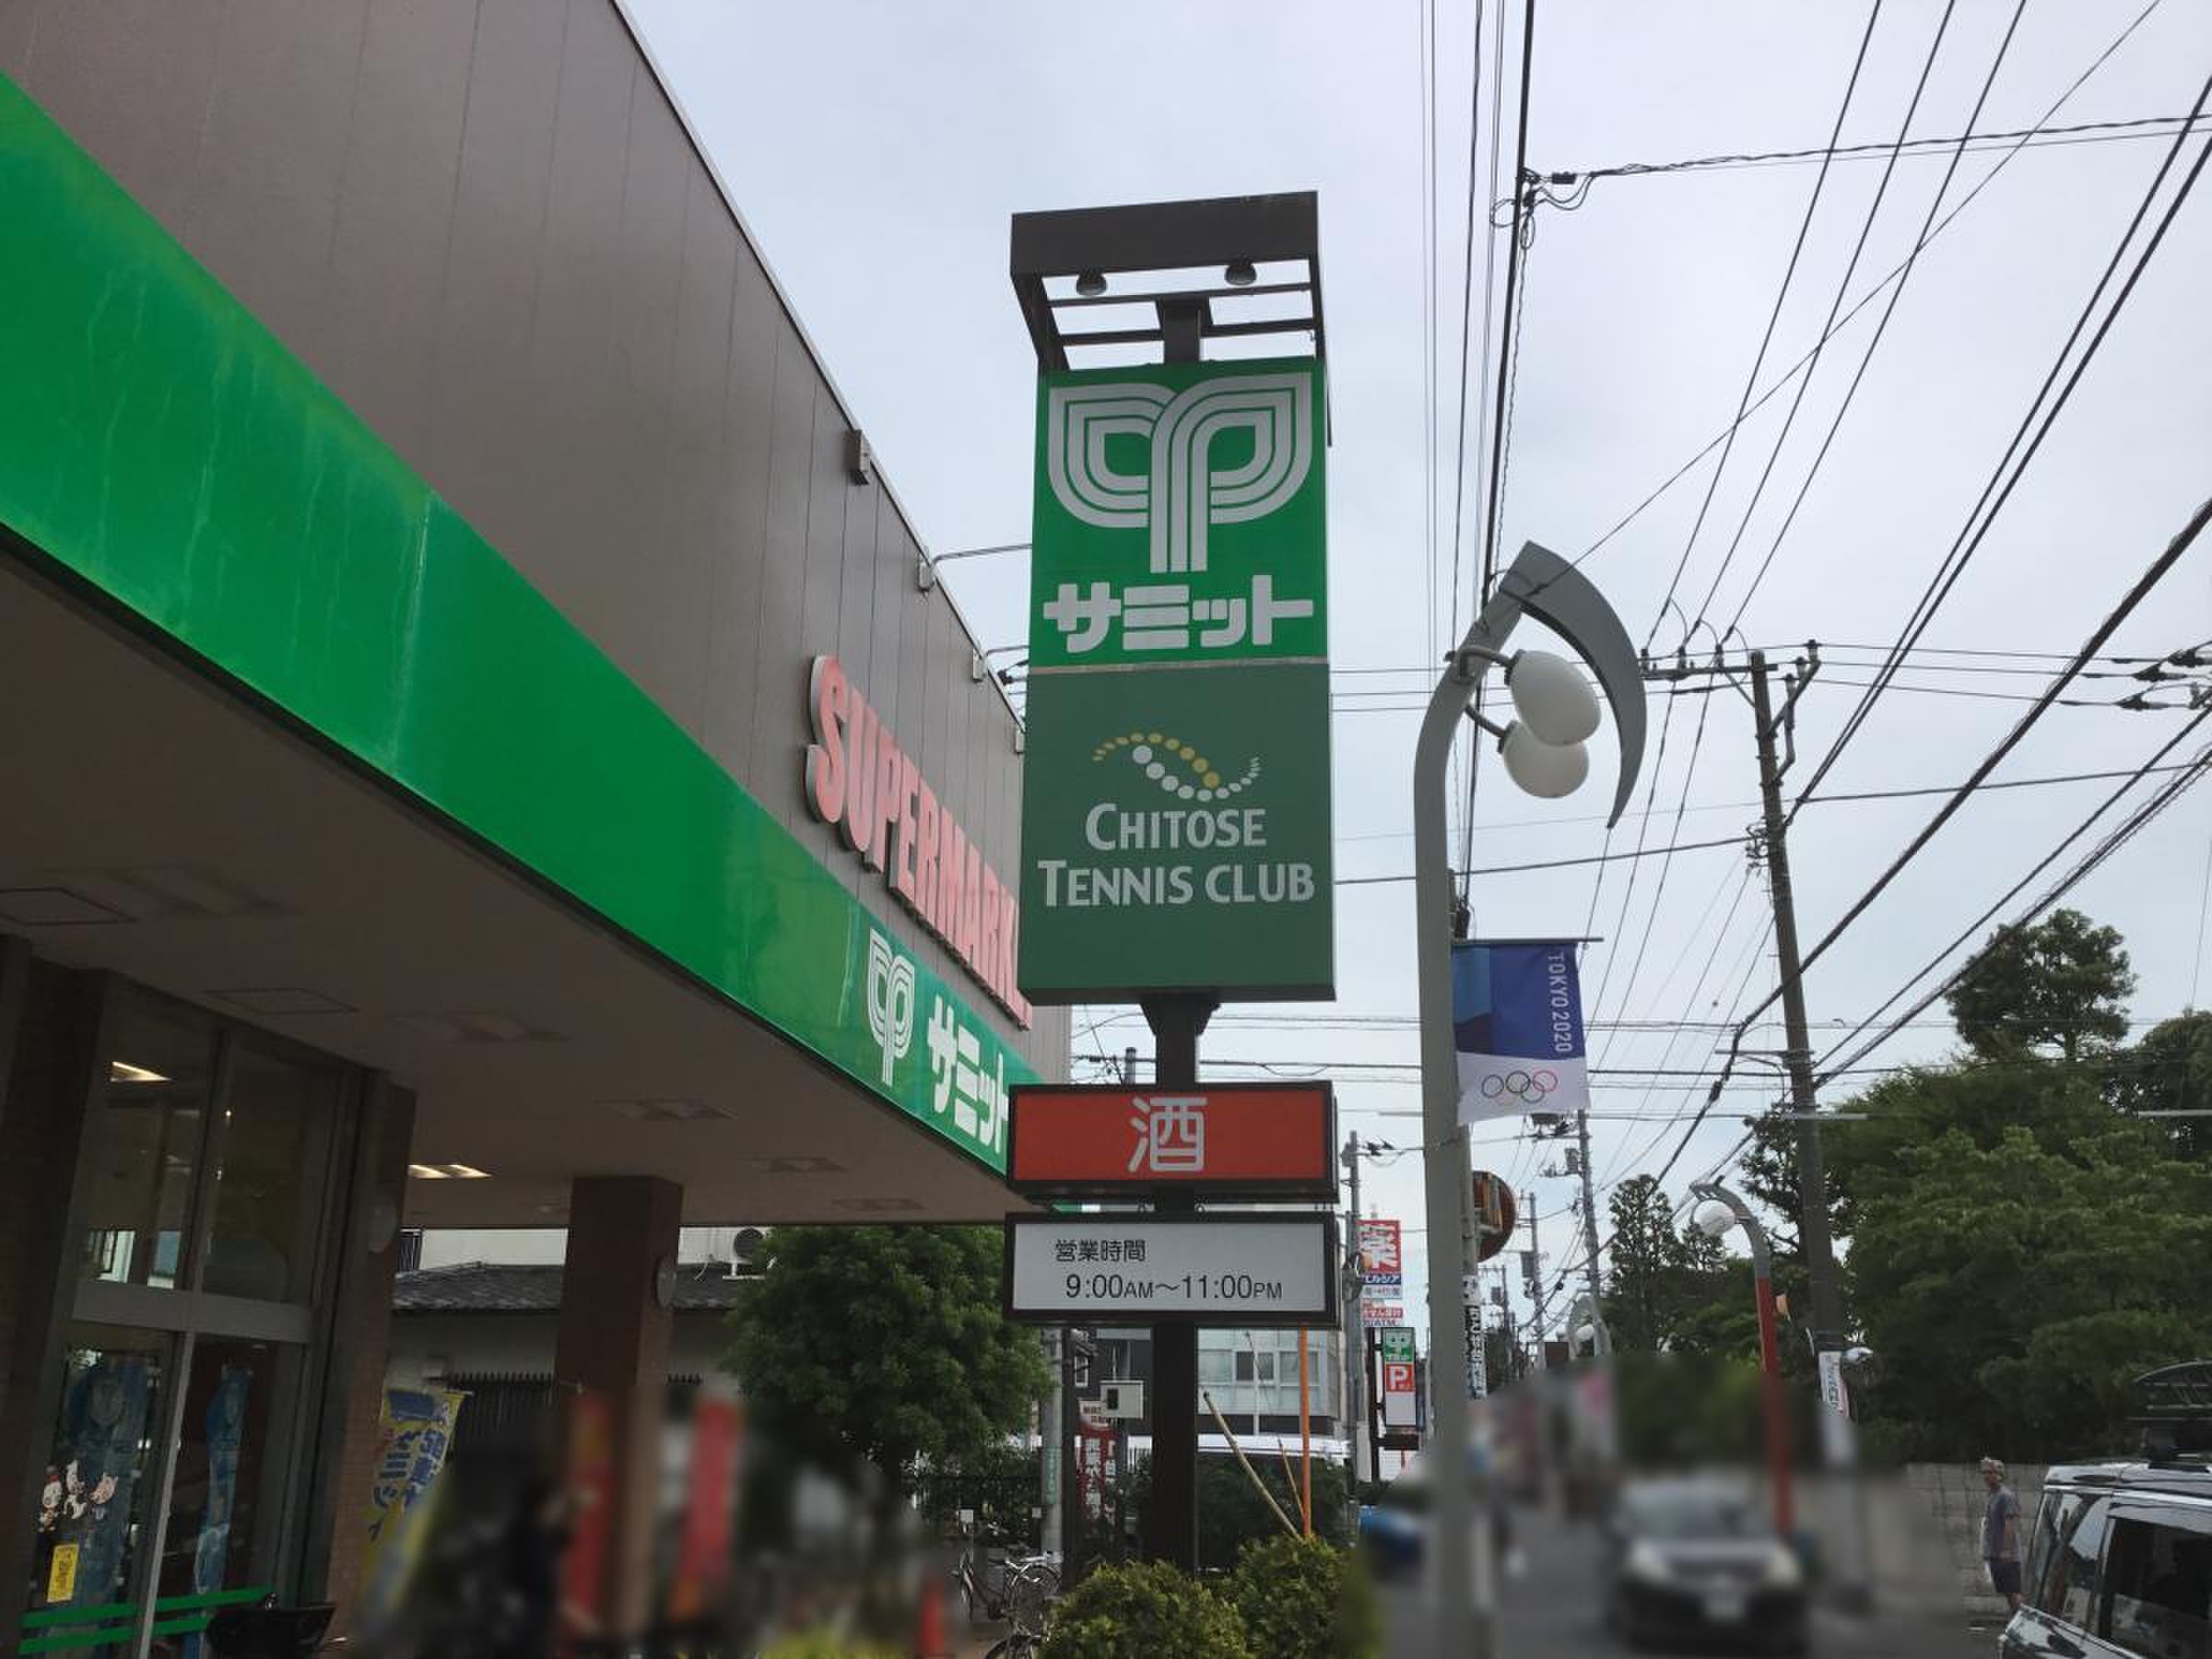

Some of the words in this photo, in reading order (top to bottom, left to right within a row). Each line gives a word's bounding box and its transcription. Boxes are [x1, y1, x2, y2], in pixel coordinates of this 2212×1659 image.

[1043, 574, 1313, 653] サミット
[1085, 803, 1266, 851] CHITOSE
[1037, 859, 1194, 907] TENNIS
[1205, 863, 1315, 903] CLUB
[1547, 951, 1570, 1007] TOKYO
[1552, 1012, 1573, 1053] 2020
[927, 994, 1009, 1155] サミット
[1127, 1097, 1208, 1172] 酒
[1055, 1239, 1147, 1263] 営業時間
[1389, 1364, 1409, 1391] P
